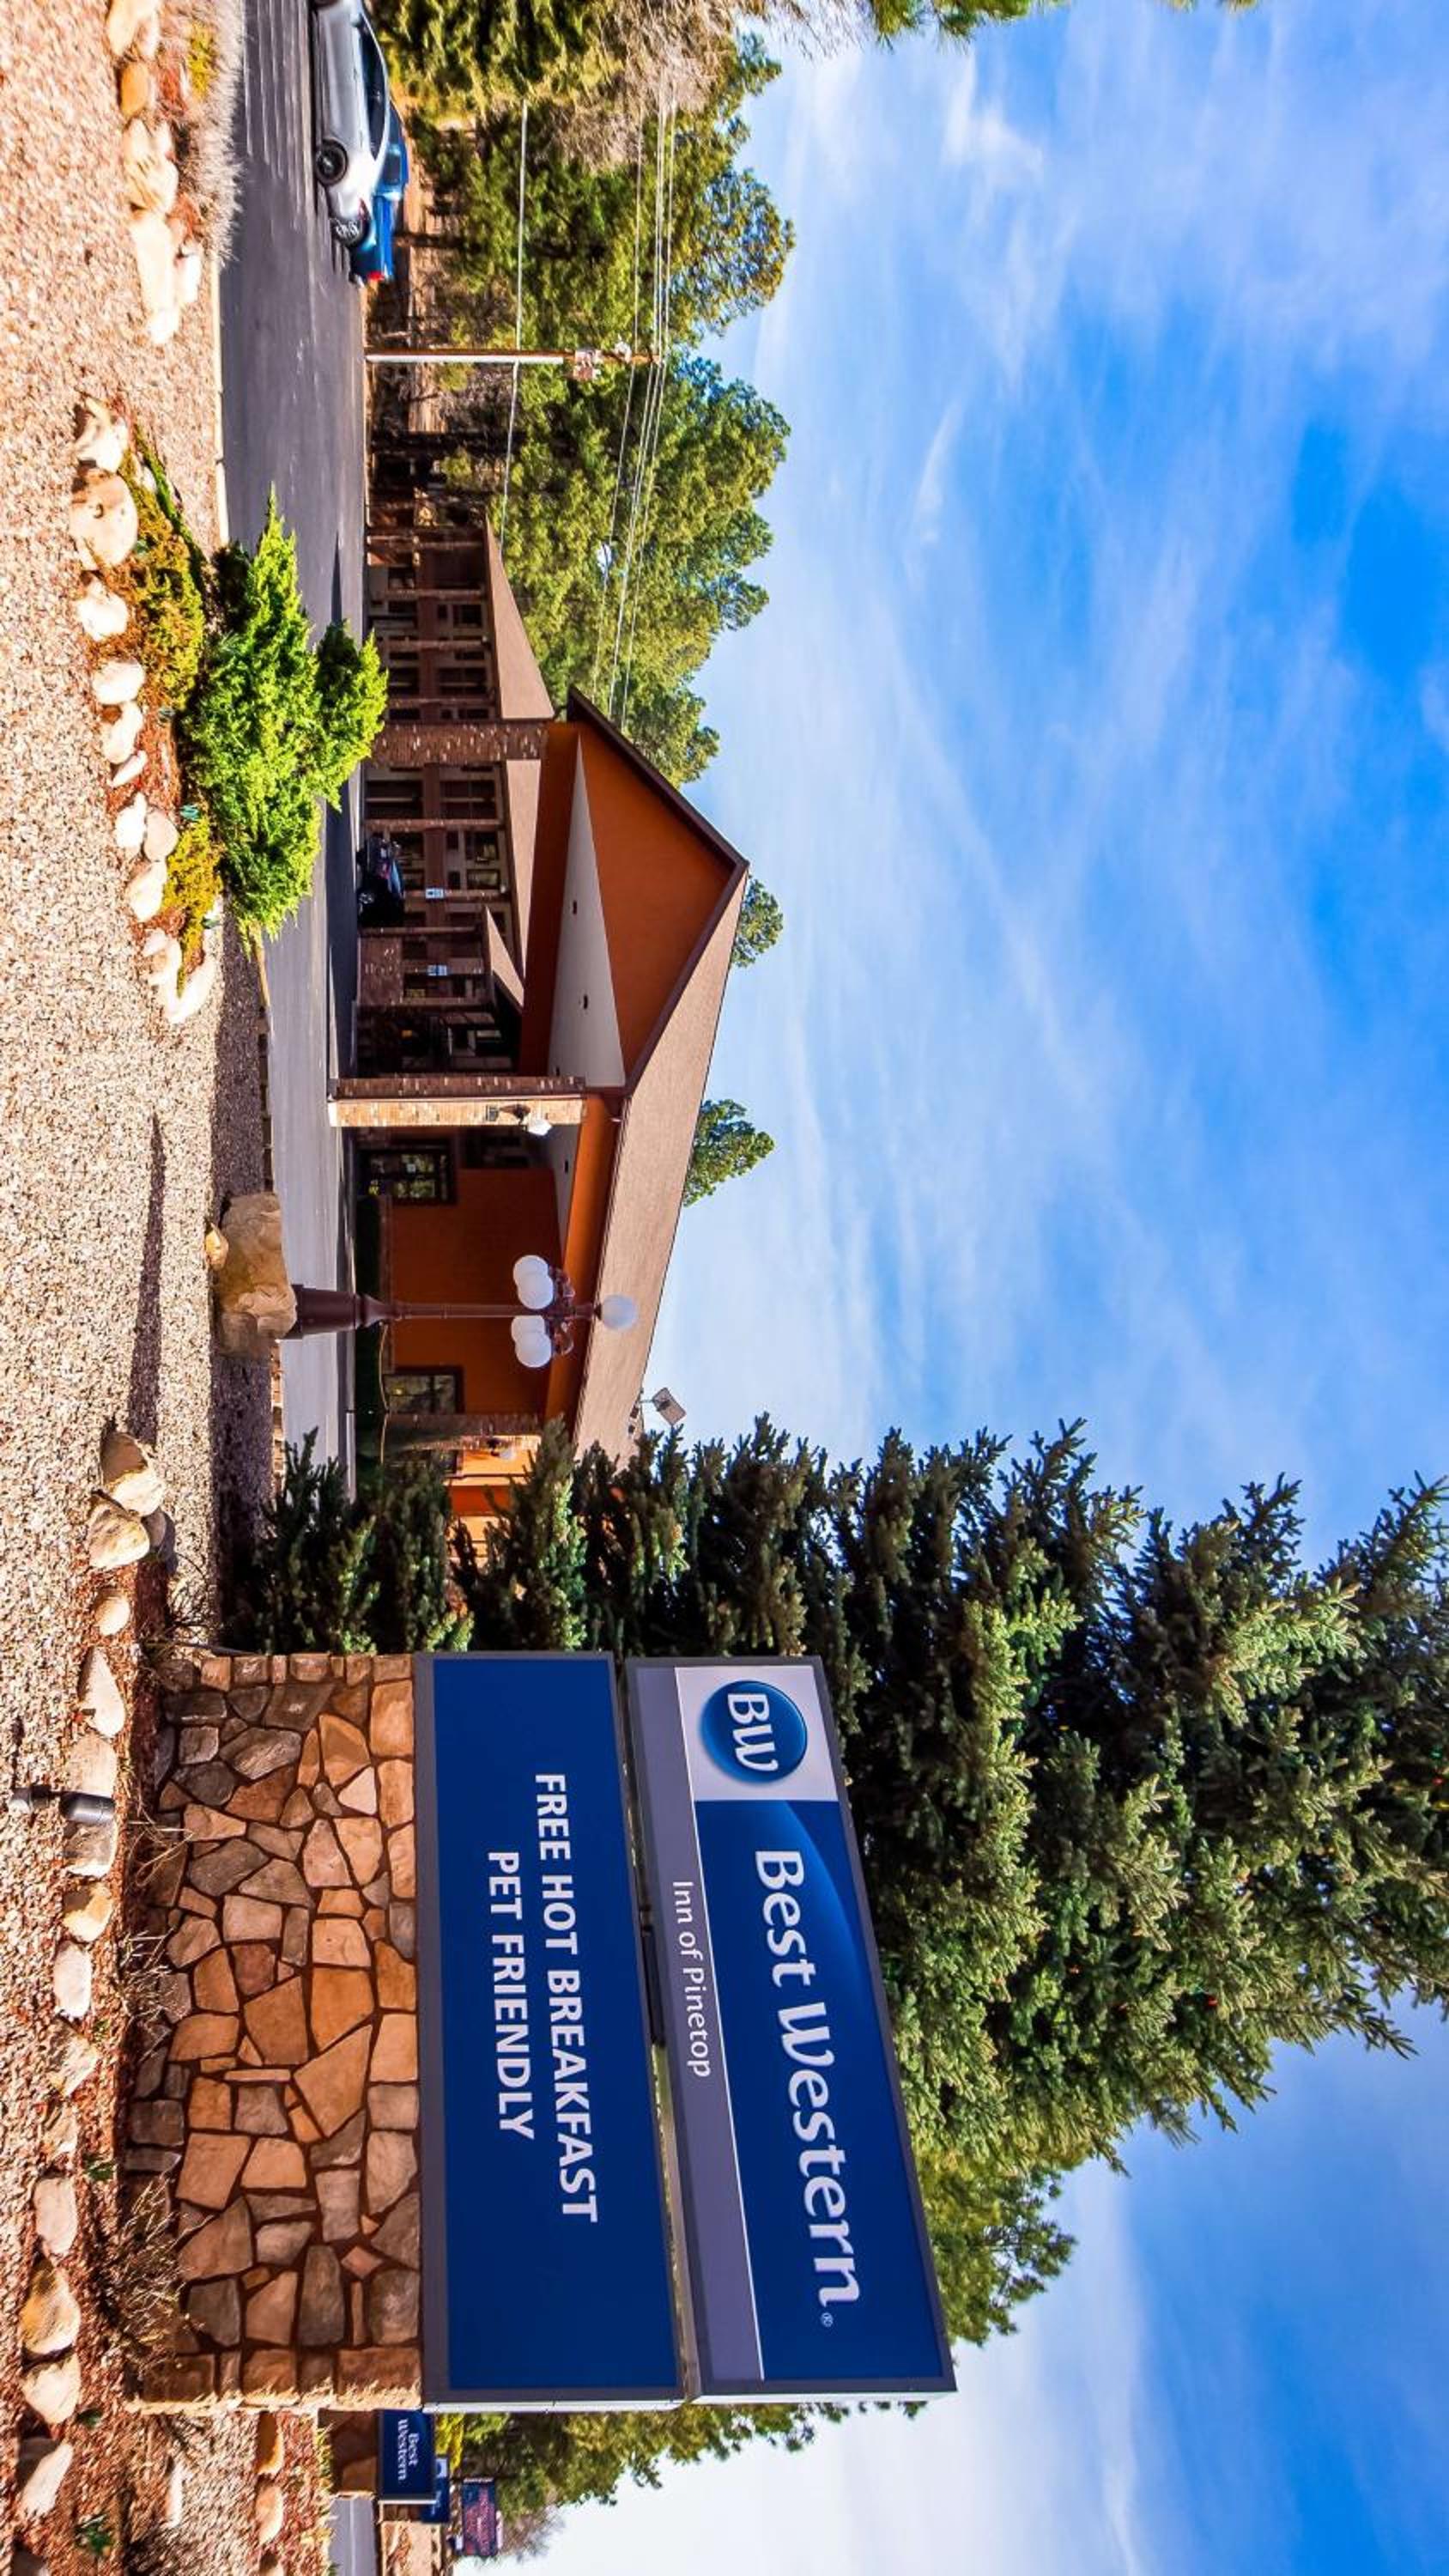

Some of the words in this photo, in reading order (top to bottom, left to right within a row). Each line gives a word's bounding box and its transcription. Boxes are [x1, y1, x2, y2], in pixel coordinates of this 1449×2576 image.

[725, 1692, 779, 1773] BW
[535, 1773, 572, 1861] FREE
[488, 1851, 523, 1921] PET
[542, 1874, 578, 1955] HOT
[671, 1880, 695, 1923] Inn
[755, 1850, 817, 1987] Best
[678, 1931, 705, 1964] of
[491, 1934, 535, 2140] FRIENDLY
[682, 1966, 715, 2078] Pinetop
[547, 1970, 598, 2223] BREAKFAST
[777, 2001, 861, 2306] Western
[397, 2419, 408, 2481] Western
[409, 2433, 419, 2466] Best
